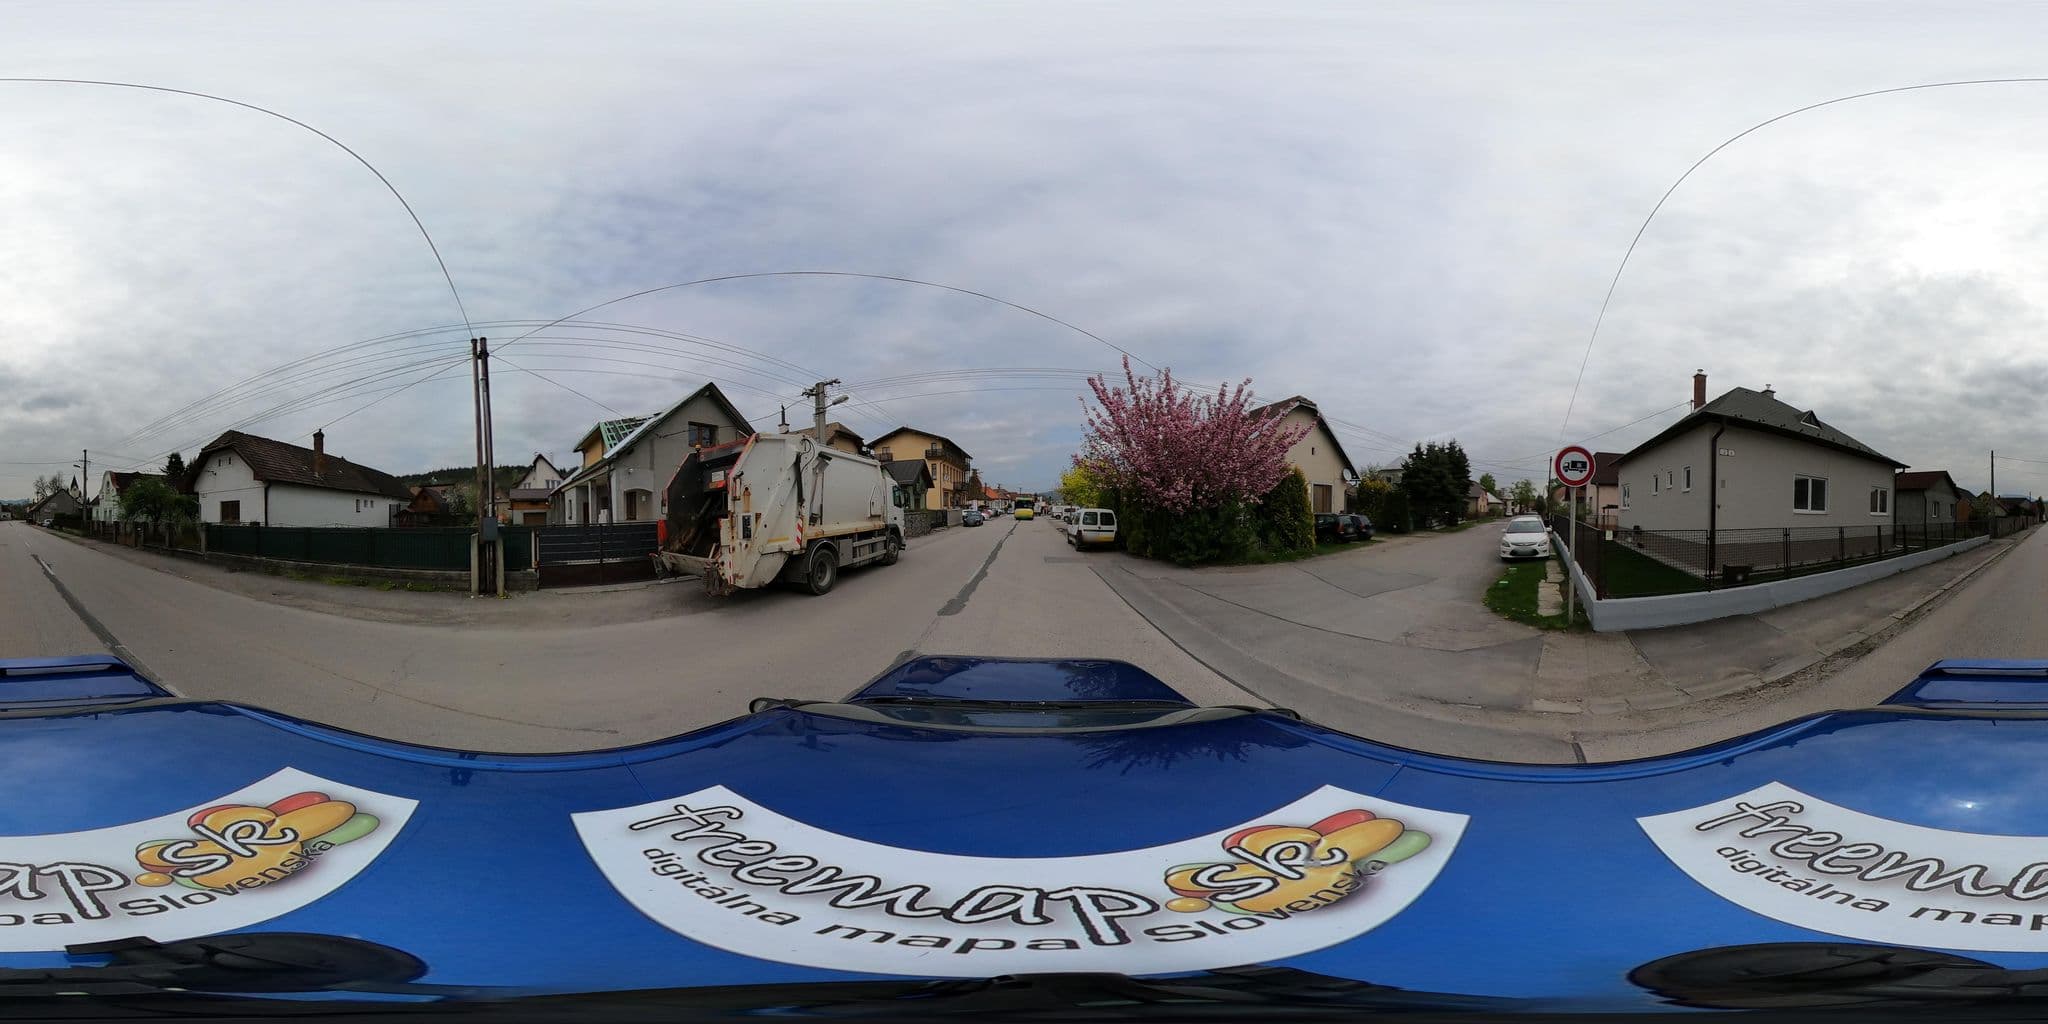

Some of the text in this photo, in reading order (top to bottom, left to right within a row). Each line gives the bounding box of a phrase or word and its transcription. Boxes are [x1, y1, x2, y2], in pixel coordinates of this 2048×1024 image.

[118, 839, 337, 916] Slovenska
[643, 848, 801, 925] digitálna
[814, 924, 1081, 954] mapa
[1716, 846, 1890, 912] digitálna
